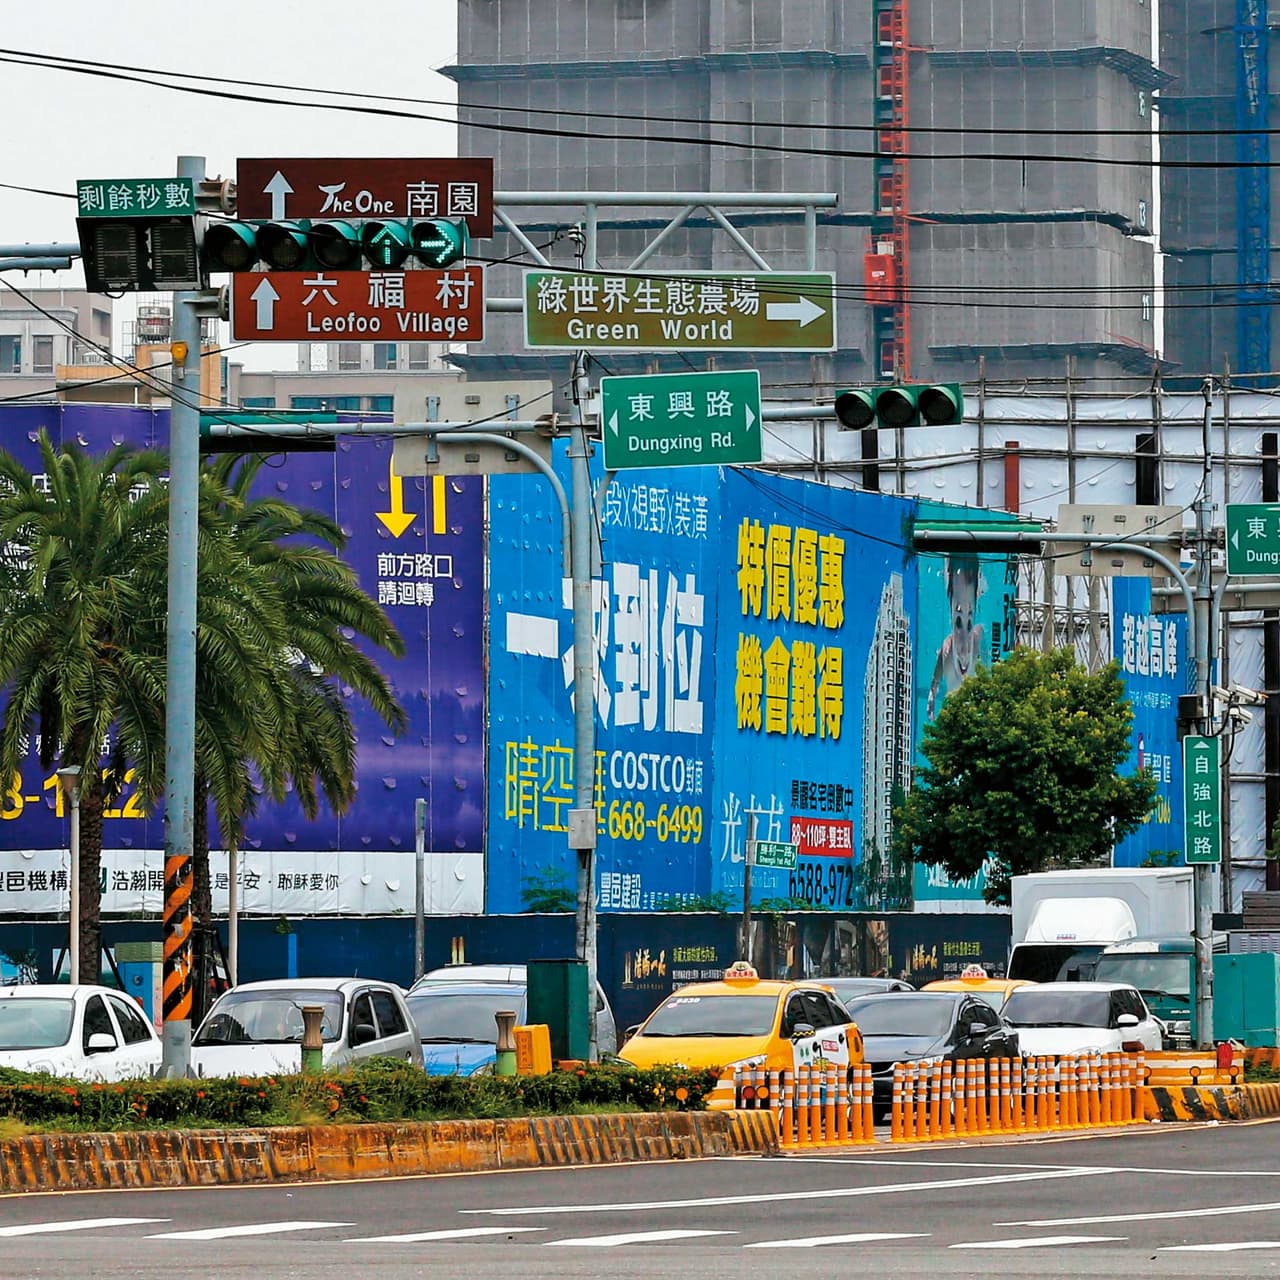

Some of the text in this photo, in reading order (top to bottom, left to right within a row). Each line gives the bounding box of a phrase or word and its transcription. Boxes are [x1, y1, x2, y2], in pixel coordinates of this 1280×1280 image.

[79, 183, 191, 211] 剩餘秒數
[406, 181, 479, 216] 南園
[302, 272, 474, 309] 六福村
[538, 276, 760, 316] 綠世界生態農場
[307, 311, 470, 337] Leofoo Village
[567, 320, 733, 340] Green World
[628, 391, 734, 421] 東興路
[628, 432, 735, 454] Dungxing Rd.
[377, 553, 453, 578] 前方路口
[737, 517, 845, 629] 特價優惠
[377, 581, 434, 606] 請迴轉
[1122, 613, 1177, 680] 超越高峰
[735, 632, 844, 739] 機會難得
[610, 750, 686, 794] COSTCO
[609, 800, 703, 844] 668-6499
[1193, 755, 1212, 856] 自強北路
